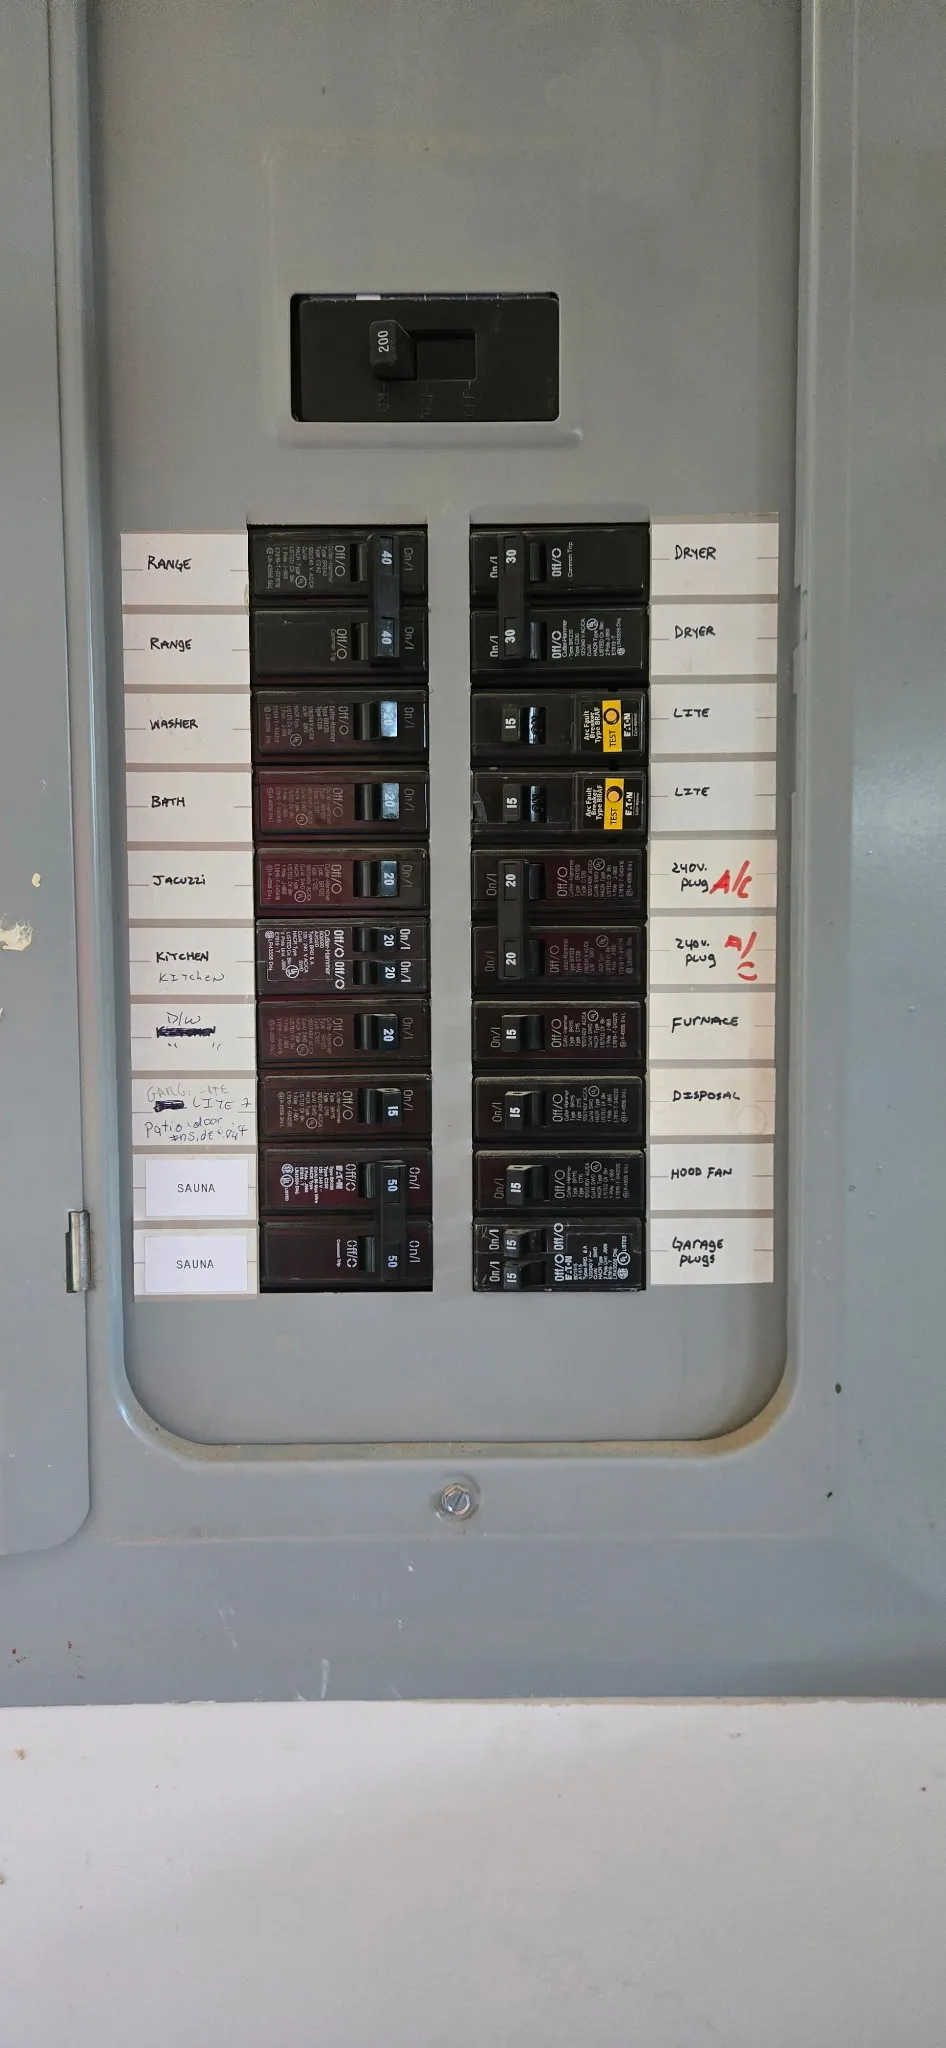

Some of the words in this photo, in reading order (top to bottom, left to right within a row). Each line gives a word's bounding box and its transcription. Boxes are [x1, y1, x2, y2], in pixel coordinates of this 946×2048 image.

[377, 329, 390, 353] 200
[382, 551, 392, 564] 40
[506, 550, 516, 563] 30
[674, 544, 717, 561] DRYER
[147, 556, 192, 572] RANGE
[382, 631, 392, 644] 40
[505, 629, 515, 643] 30
[674, 625, 716, 639] DRYER
[384, 713, 393, 725] 20
[673, 708, 711, 718] LITE
[149, 718, 199, 730] WASHER
[505, 718, 516, 729] 15
[674, 786, 711, 797] LITE
[151, 796, 186, 808] BATH
[385, 793, 394, 807] 20
[507, 798, 517, 809] 15
[384, 872, 394, 885] 20
[506, 874, 516, 887] 20
[708, 859, 753, 899] A/C
[384, 935, 394, 946] 20
[506, 952, 516, 965] 20
[385, 967, 395, 979] 20
[166, 1011, 202, 1025] D/W
[384, 1029, 394, 1041] 20
[506, 1029, 516, 1039] 15
[672, 1089, 741, 1103] DISPOSAL
[193, 1096, 234, 1110] LITE
[388, 1106, 398, 1116] 15
[510, 1107, 520, 1117] 15
[670, 1168, 702, 1181] HOOD
[707, 1167, 733, 1180] FAN
[177, 1183, 217, 1193] SAUNA
[388, 1179, 397, 1192] 50
[511, 1183, 521, 1192] 15
[507, 1240, 516, 1249] 15
[176, 1259, 216, 1270] SAUNA
[388, 1255, 397, 1267] 50
[507, 1273, 517, 1282] 15
